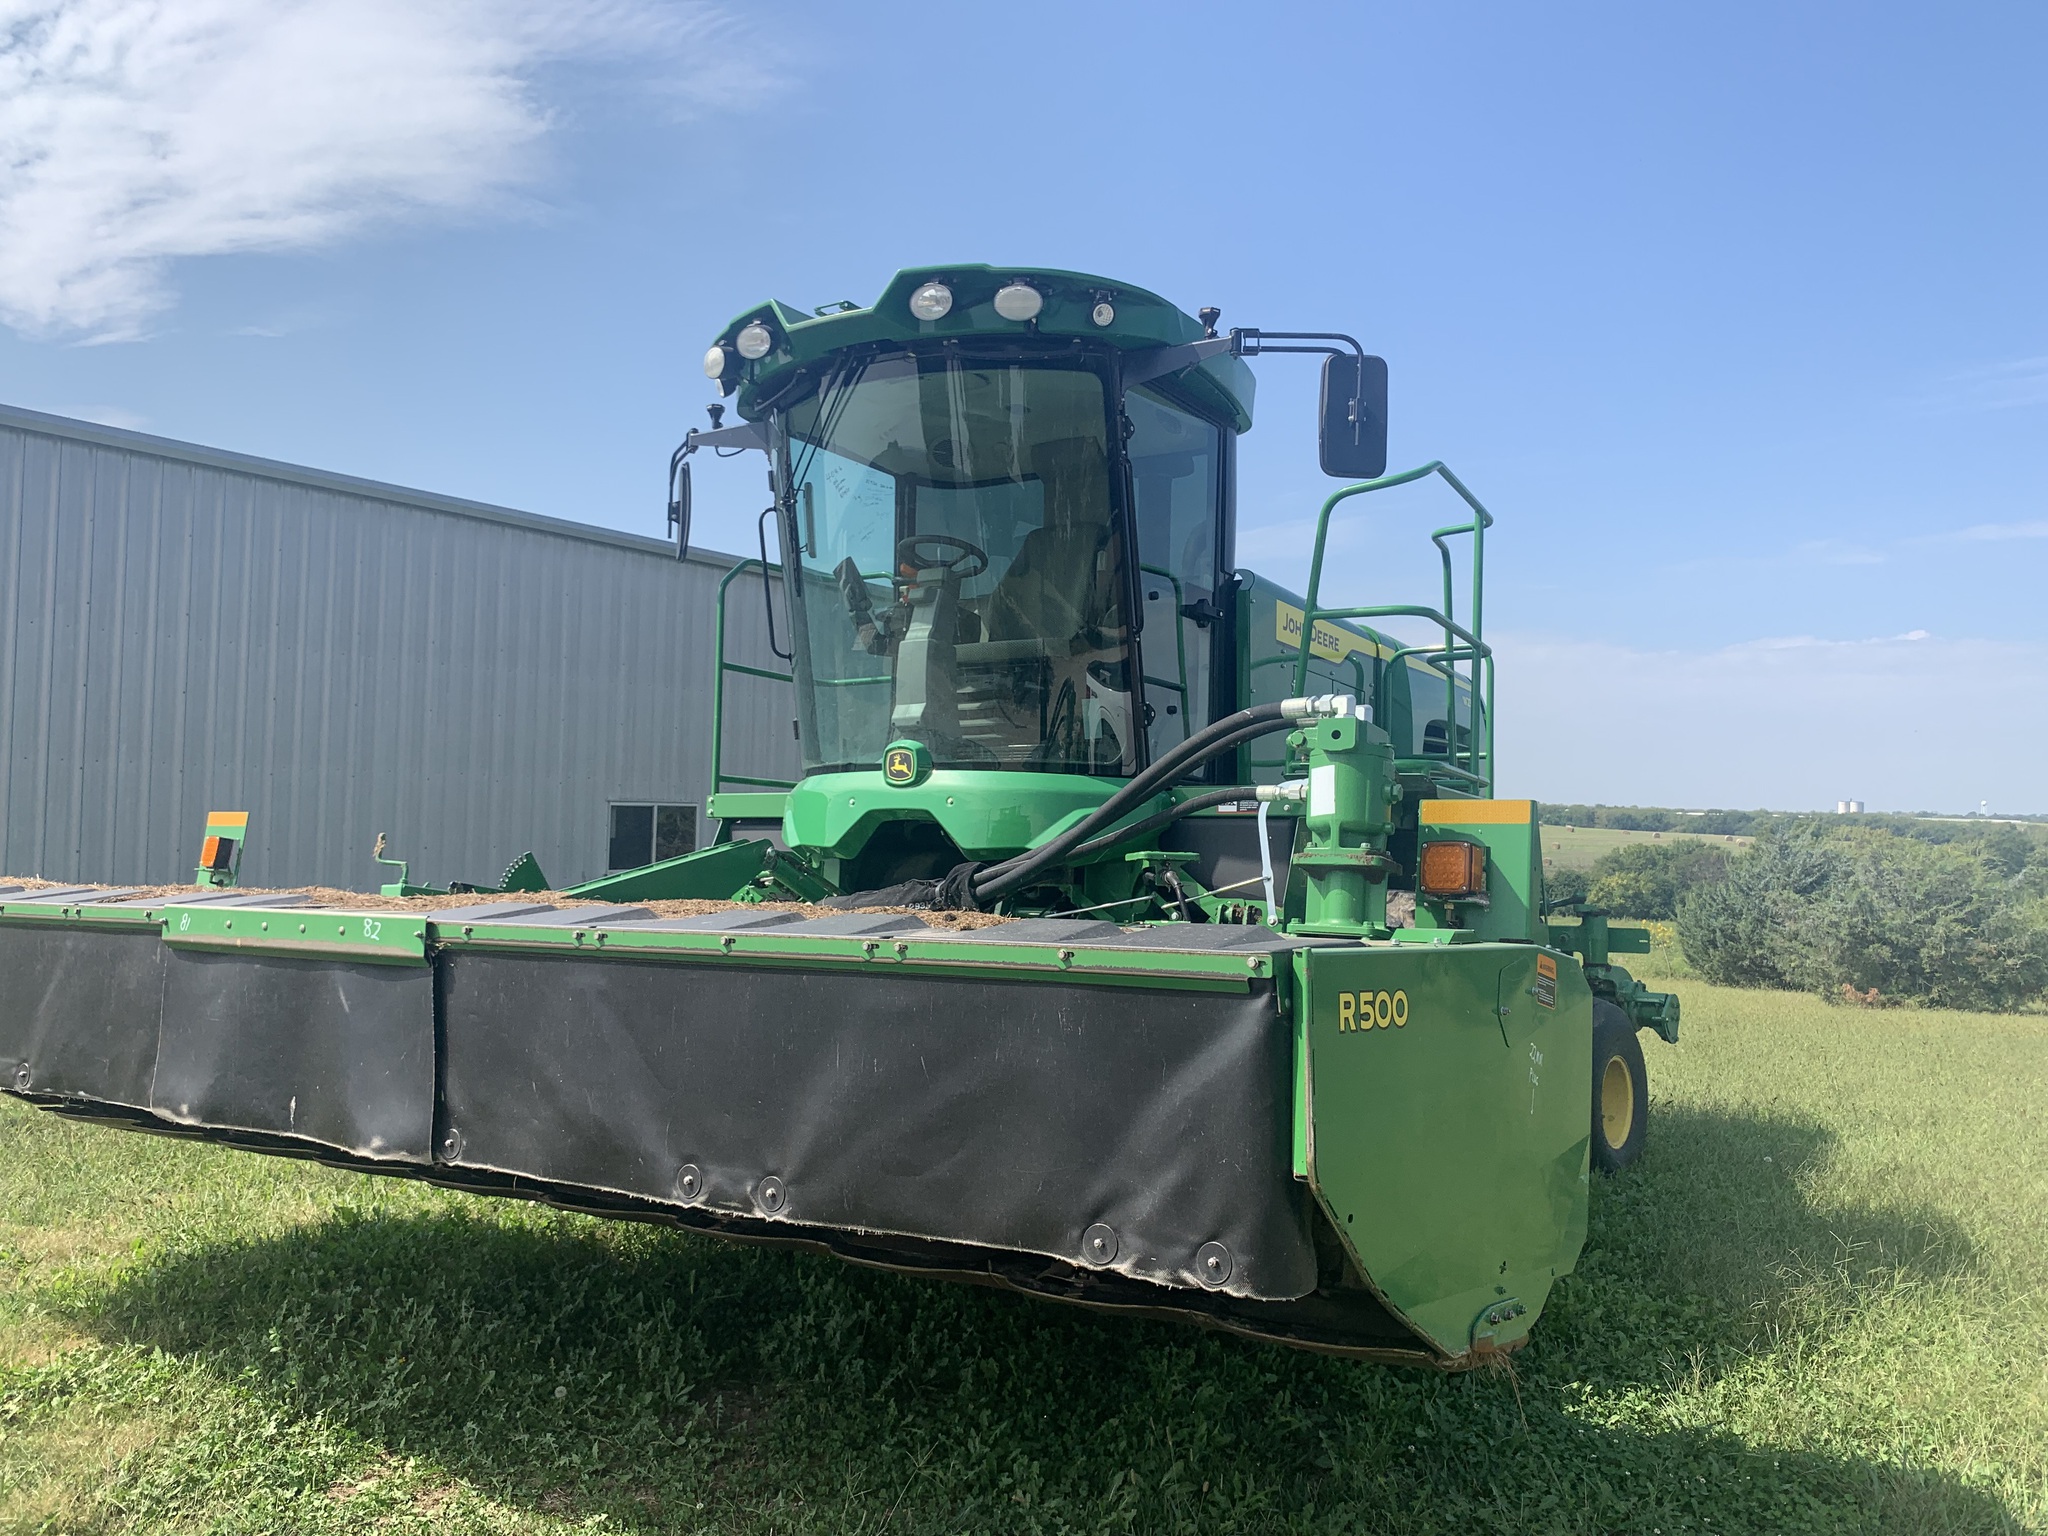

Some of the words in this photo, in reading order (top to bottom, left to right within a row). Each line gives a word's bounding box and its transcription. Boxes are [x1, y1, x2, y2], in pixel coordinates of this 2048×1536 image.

[1283, 613, 1303, 637] JOH
[1311, 624, 1340, 652] DEERE
[180, 913, 191, 931] 81
[363, 919, 381, 940] 82
[1339, 989, 1409, 1033] R500
